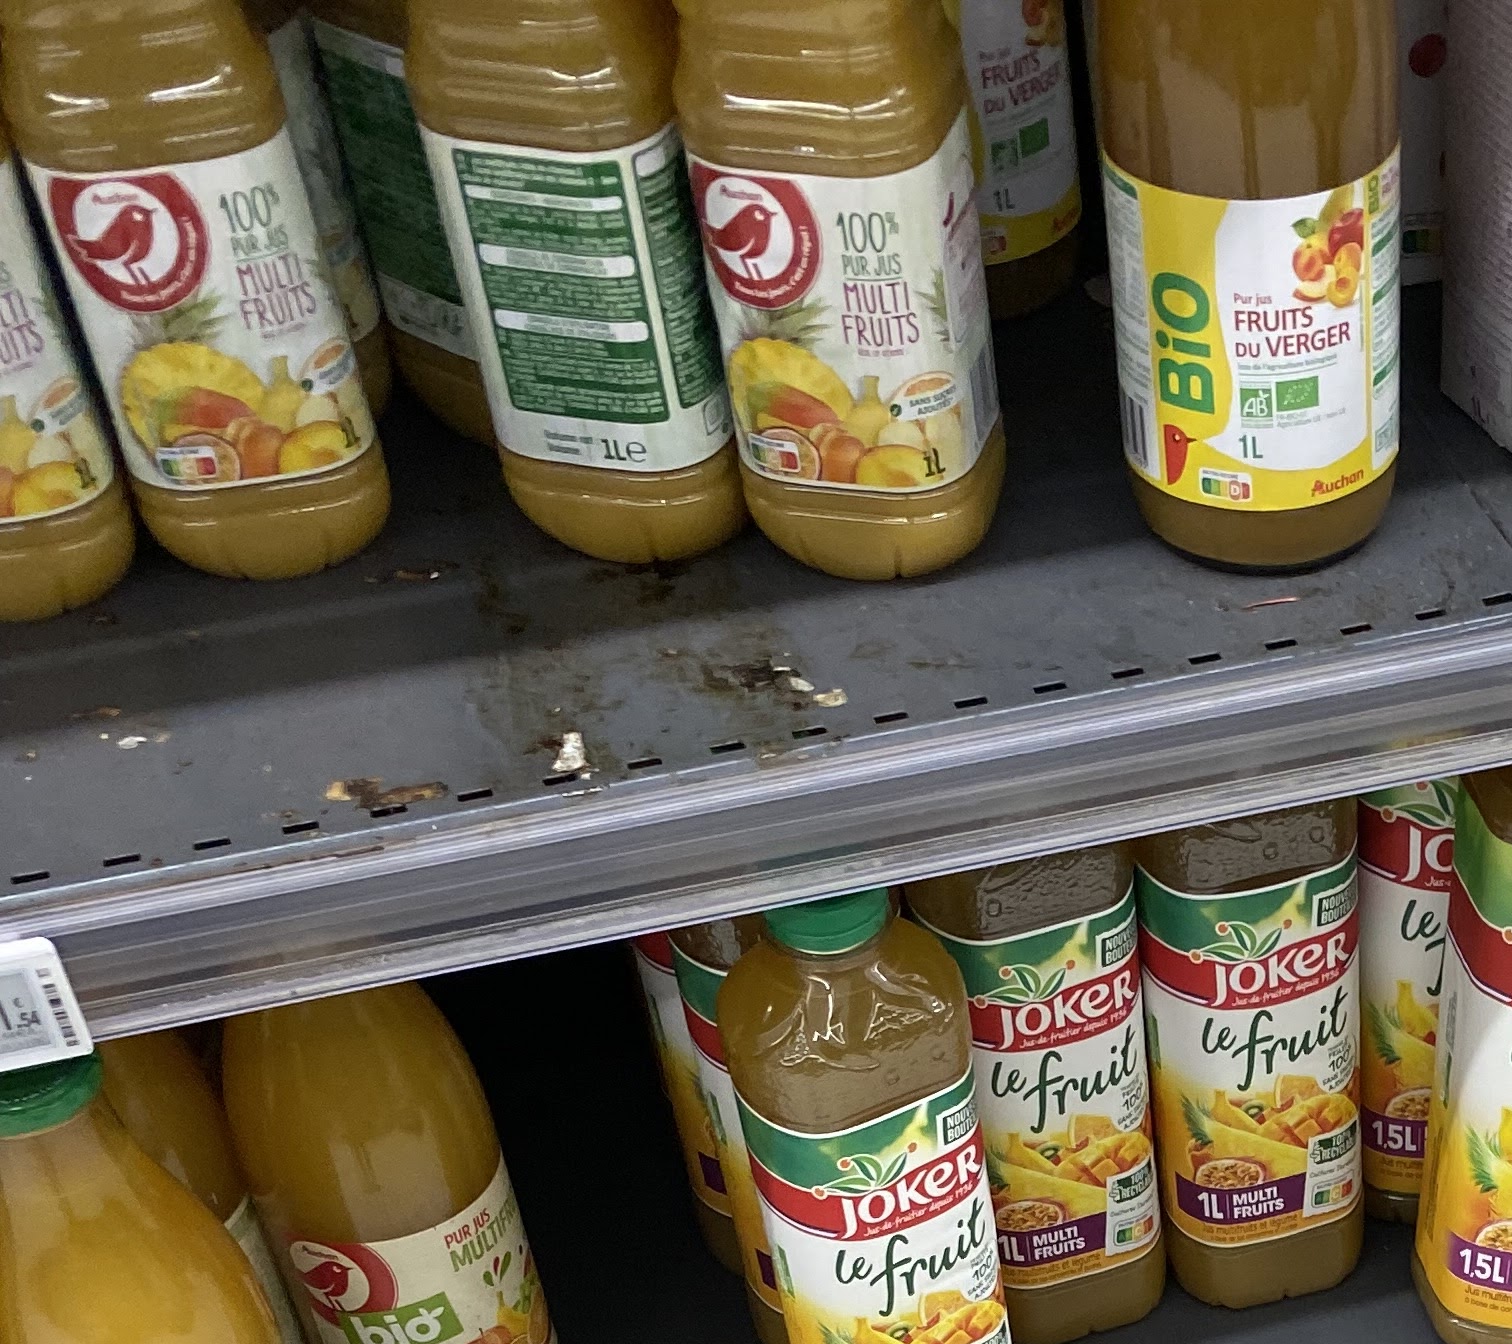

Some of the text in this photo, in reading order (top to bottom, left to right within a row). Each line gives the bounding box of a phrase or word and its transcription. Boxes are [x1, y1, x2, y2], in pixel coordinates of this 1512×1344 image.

[836, 212, 899, 254] 100%
[842, 254, 901, 276] PUR JUS
[240, 281, 316, 330] FRUITS
[843, 282, 912, 315] MULTI
[841, 312, 920, 347] FRUITS
[1235, 307, 1313, 332] FRUITS
[1236, 322, 1350, 358] DU VERGER
[1238, 434, 1263, 459] 1L
[1311, 468, 1364, 497] Auchan
[1400, 899, 1442, 942] le
[1210, 931, 1350, 1008] JOKER
[999, 969, 1136, 1051] JOKER
[1201, 984, 1349, 1092] le fruit
[990, 1023, 1137, 1135] le fruit
[840, 1144, 982, 1240] JOKER
[1197, 1191, 1224, 1220] 1L
[1232, 1186, 1278, 1206] MULTI
[1233, 1198, 1285, 1219] FRUITS
[444, 1207, 492, 1250] PUR JUS
[1032, 1225, 1079, 1248] MULTI
[835, 1196, 986, 1317] le fruit
[997, 1234, 1025, 1262] 1L
[1033, 1237, 1086, 1261] FRUITS
[1464, 1285, 1480, 1299] Jus
